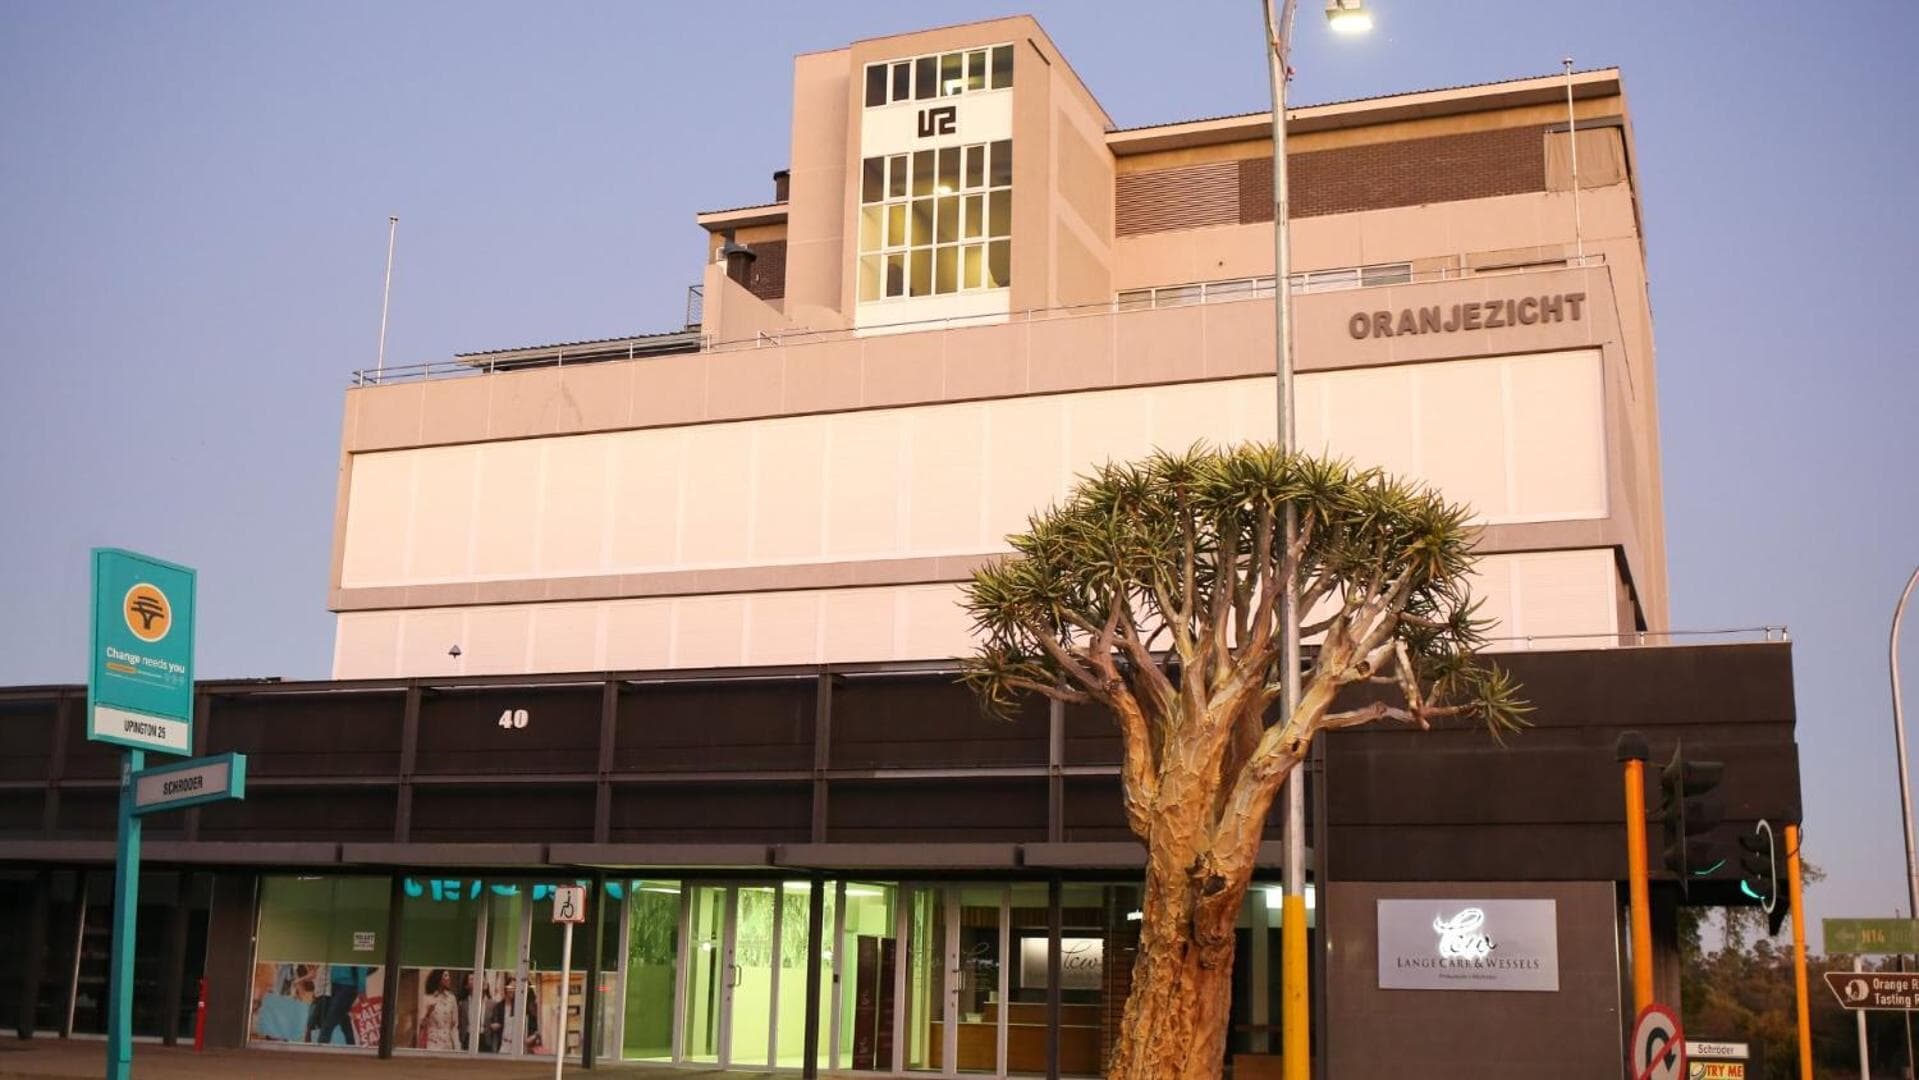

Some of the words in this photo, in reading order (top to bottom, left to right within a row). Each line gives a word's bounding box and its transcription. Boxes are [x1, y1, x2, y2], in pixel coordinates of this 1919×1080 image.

[1349, 292, 1586, 339] ORANJEZICHT
[106, 646, 140, 665] Change
[142, 657, 168, 670] needs
[168, 662, 185, 674] you
[498, 709, 529, 729] 40
[124, 720, 157, 737] UPINGTON
[158, 726, 166, 739] 25
[1474, 957, 1484, 969] &
[1486, 957, 1540, 970] WESSELS
[1873, 978, 1908, 993] Orange
[1874, 992, 1911, 1008] Tasting
[1707, 1064, 1726, 1077] TRY
[1727, 1065, 1743, 1078] ME
